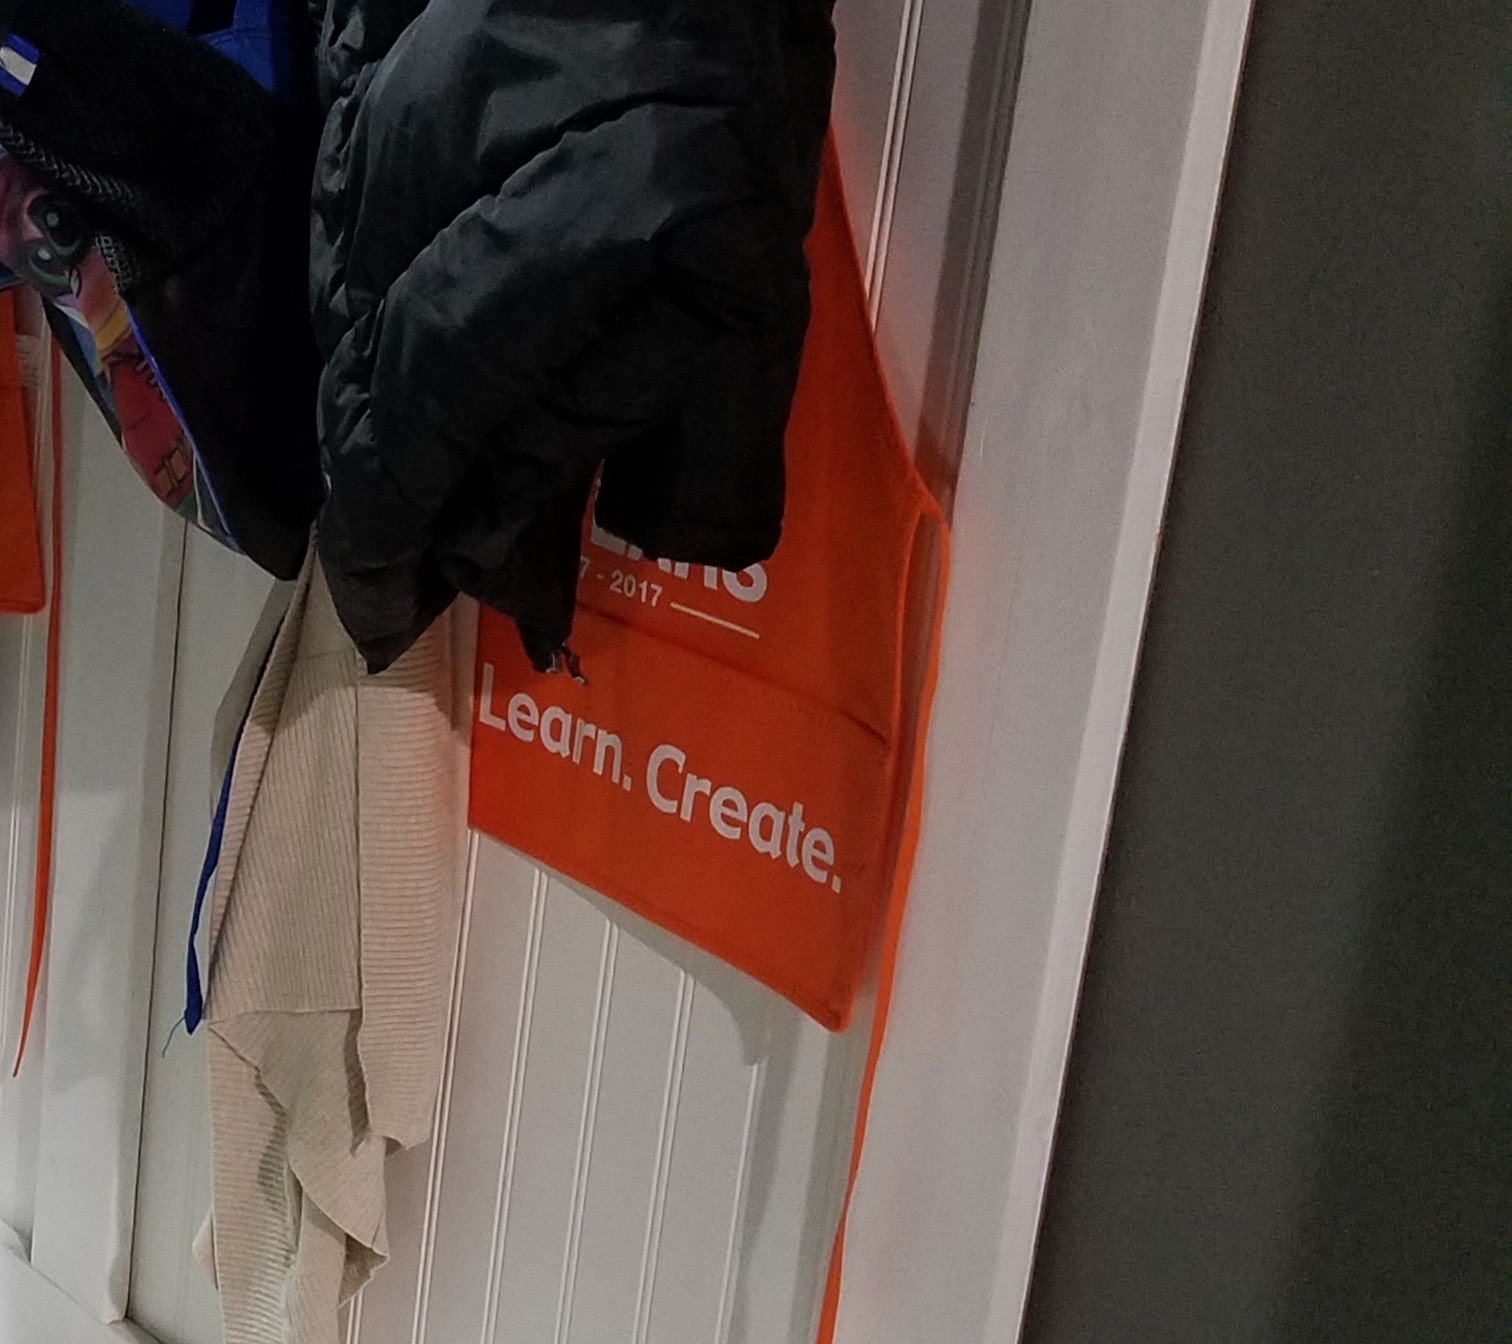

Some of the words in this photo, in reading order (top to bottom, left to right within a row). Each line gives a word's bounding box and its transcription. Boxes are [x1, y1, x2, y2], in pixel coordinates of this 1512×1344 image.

[609, 570, 663, 607] 2017
[478, 662, 632, 792] Learn.
[646, 743, 842, 895] Create.
